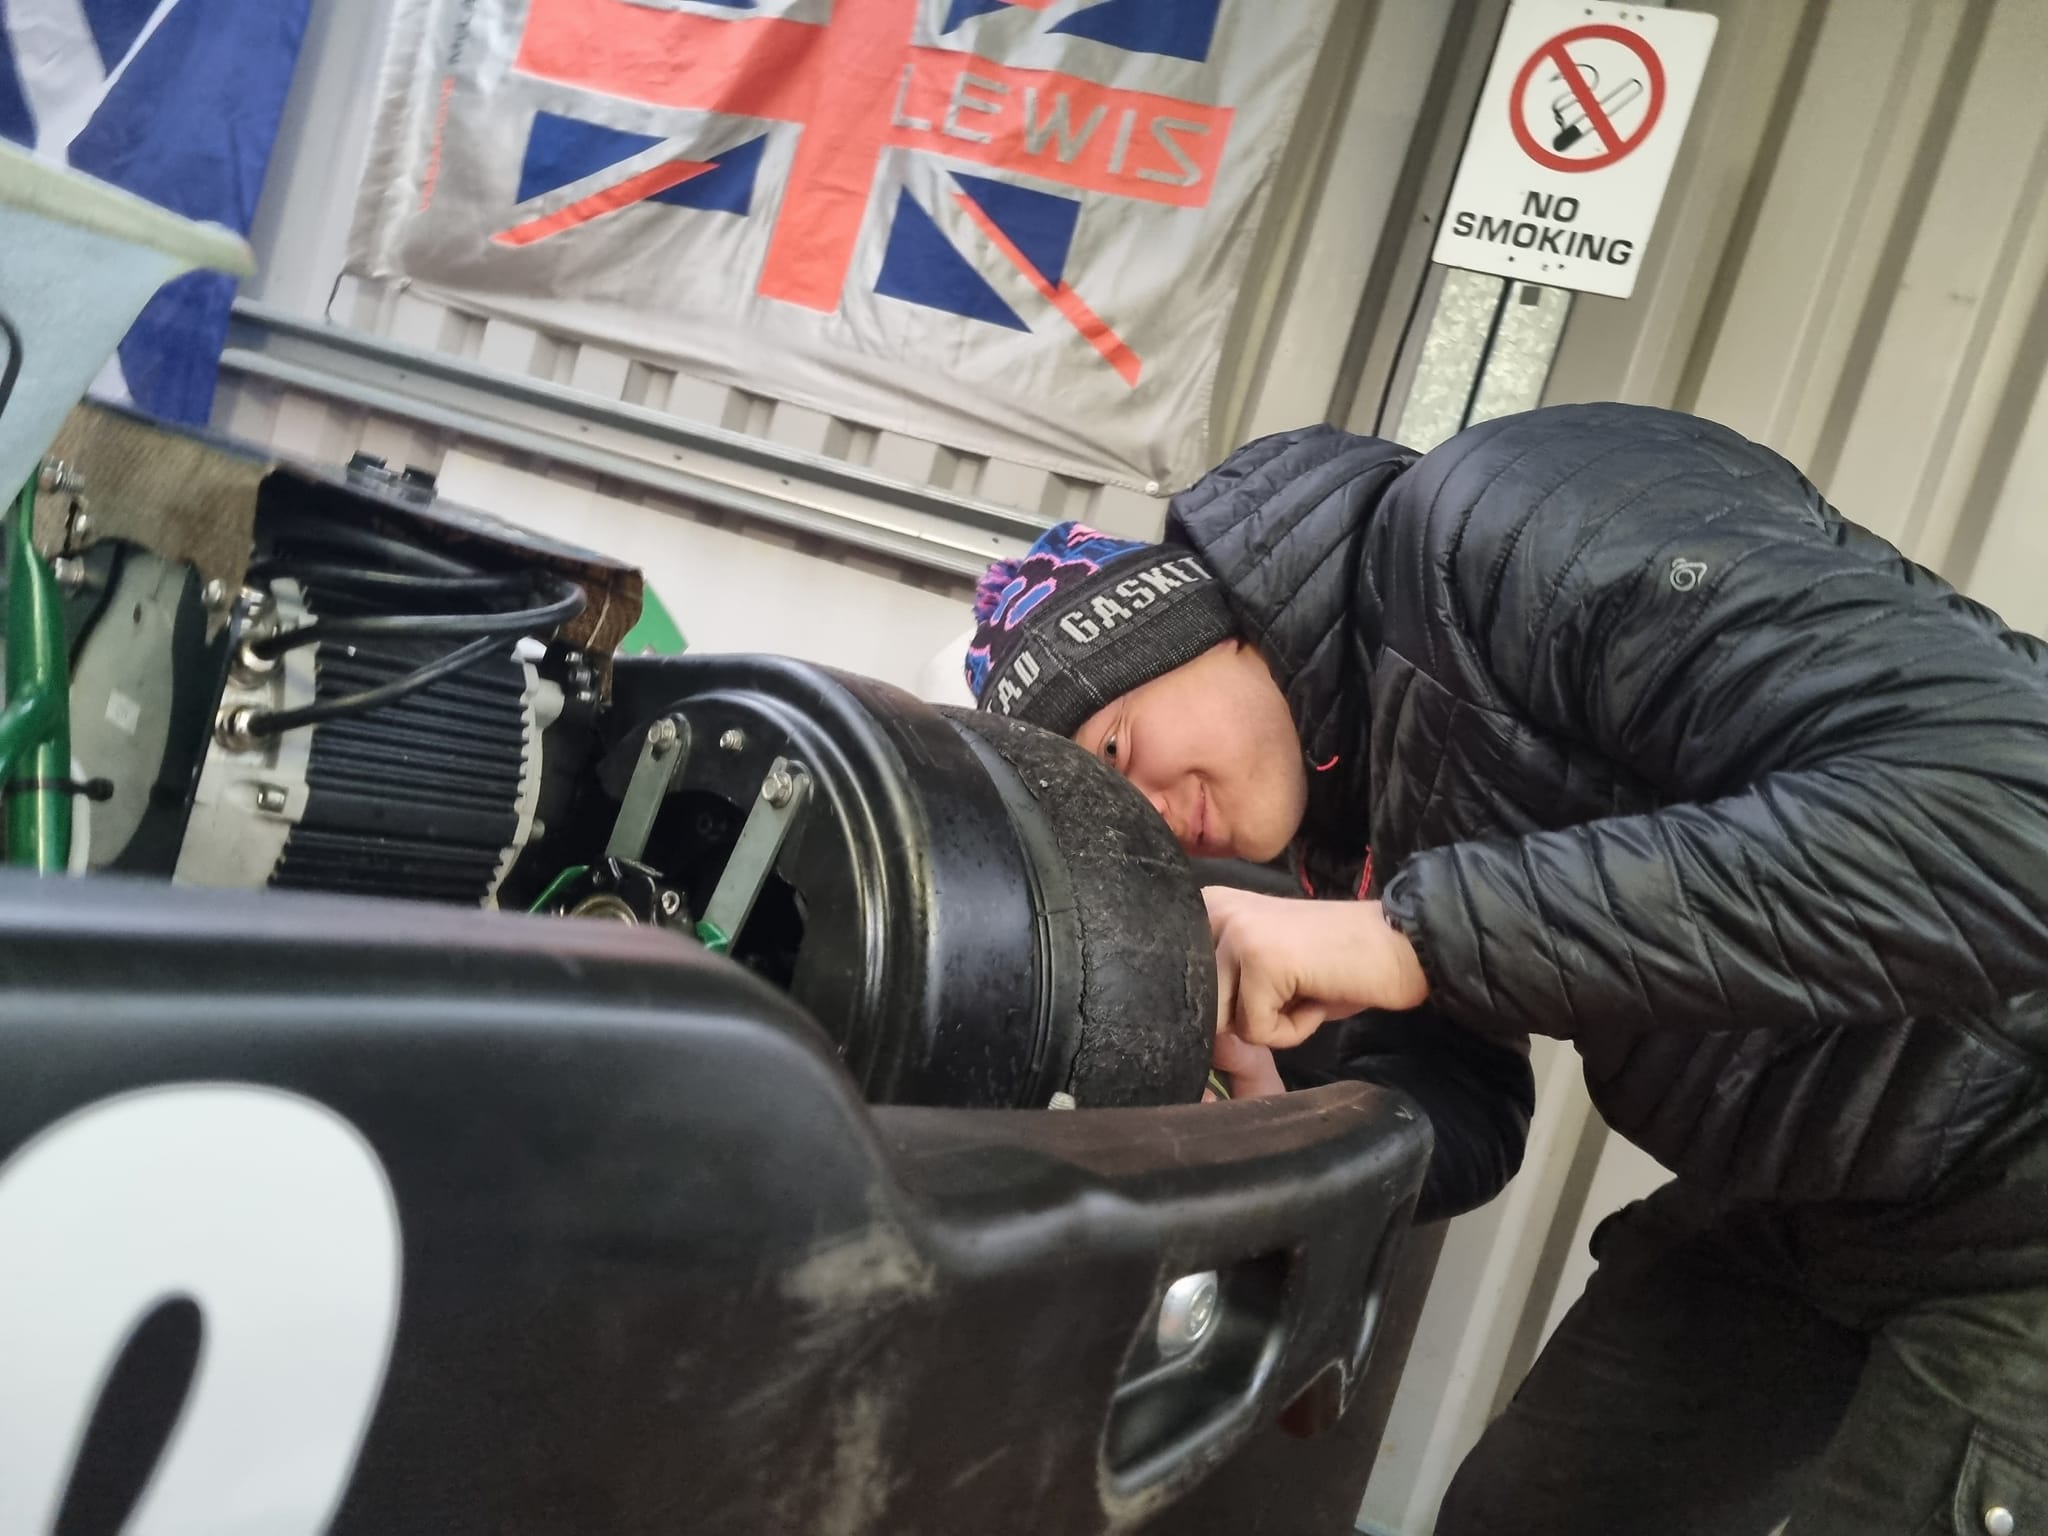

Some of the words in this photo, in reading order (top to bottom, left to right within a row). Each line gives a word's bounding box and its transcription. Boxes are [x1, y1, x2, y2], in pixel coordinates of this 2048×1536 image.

[892, 64, 1209, 187] LEWIS
[1522, 191, 1580, 223] NO
[1453, 211, 1633, 265] SMOKING
[987, 650, 1041, 715] AD
